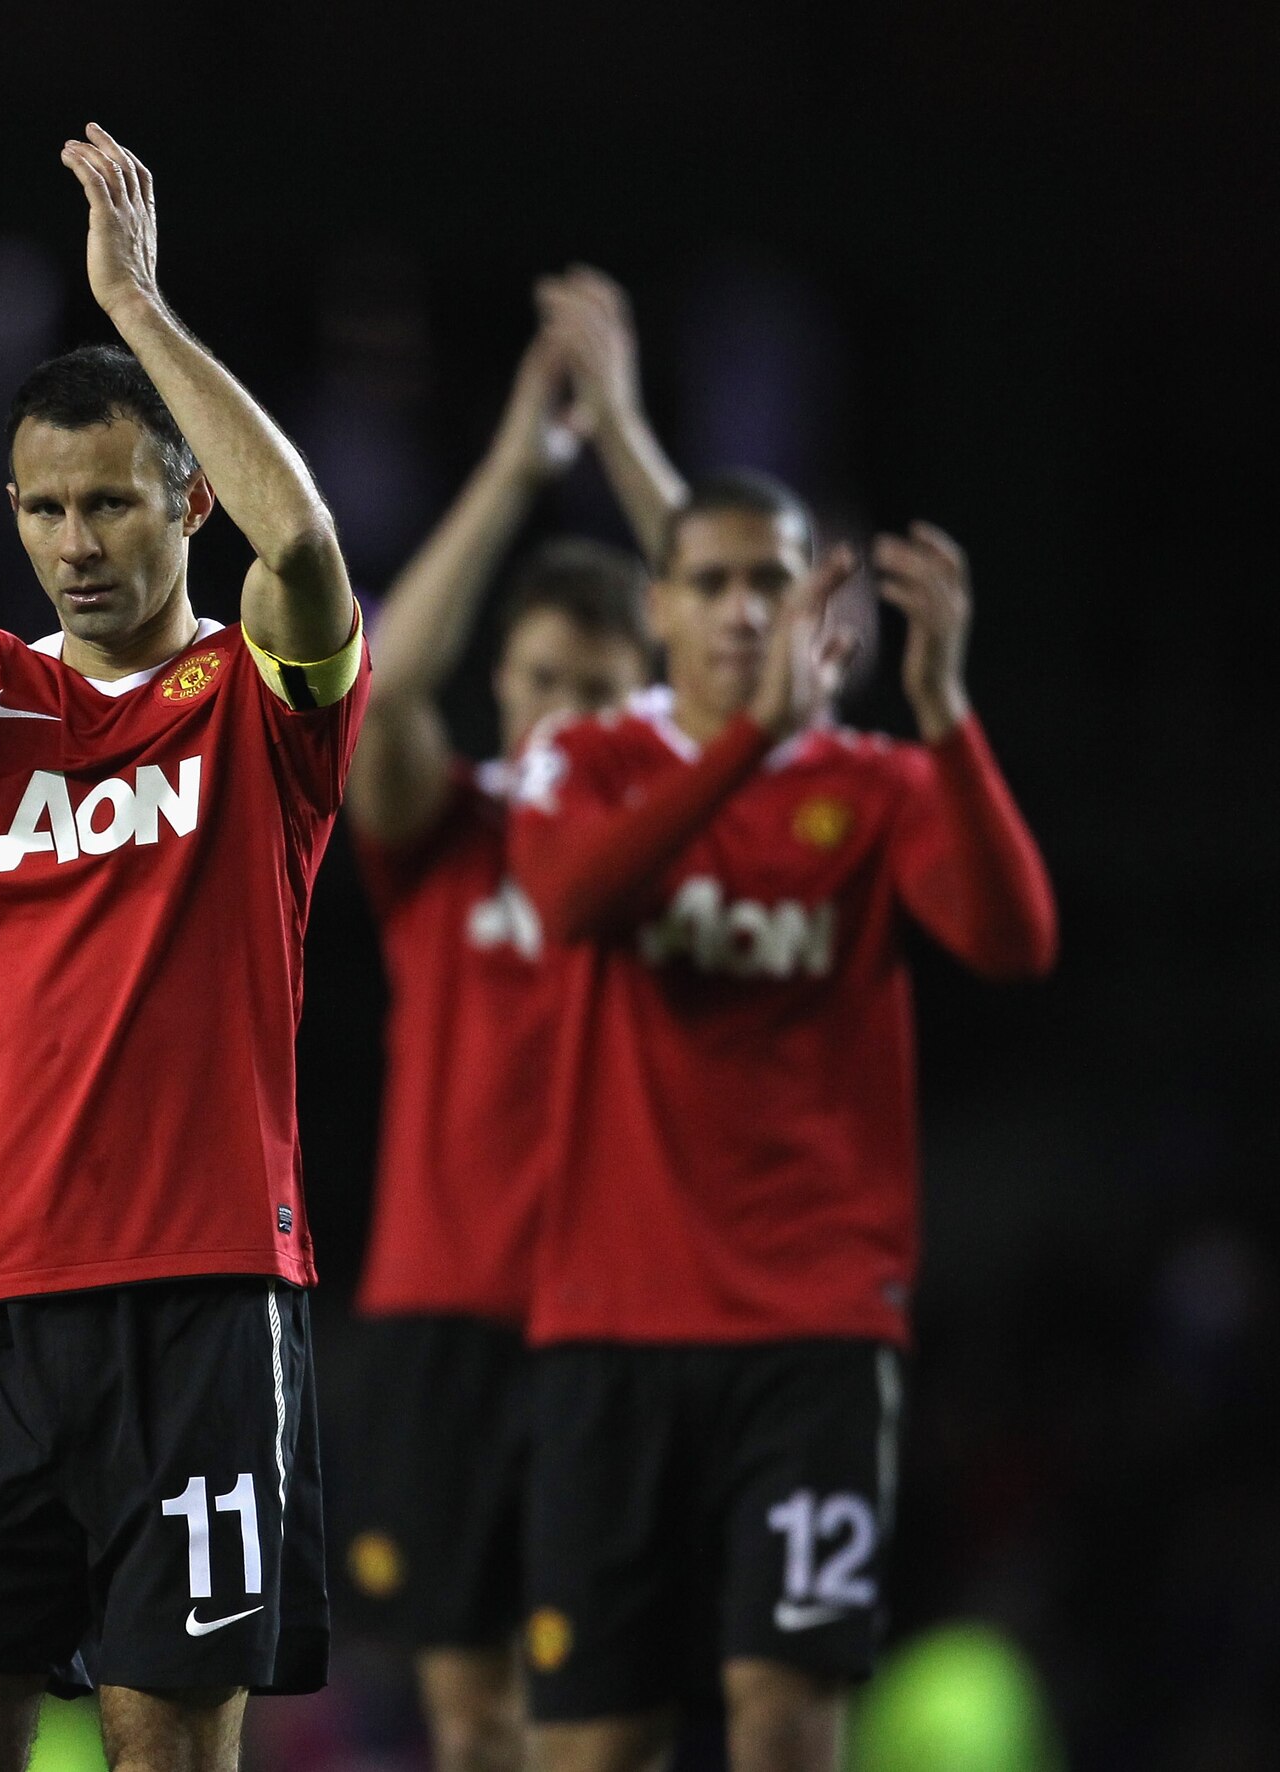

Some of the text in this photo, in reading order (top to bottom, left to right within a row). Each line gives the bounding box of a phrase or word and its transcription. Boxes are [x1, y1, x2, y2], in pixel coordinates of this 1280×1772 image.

[639, 874, 835, 979] AON
[161, 1473, 262, 1598] 11
[768, 1488, 878, 1604] 12
